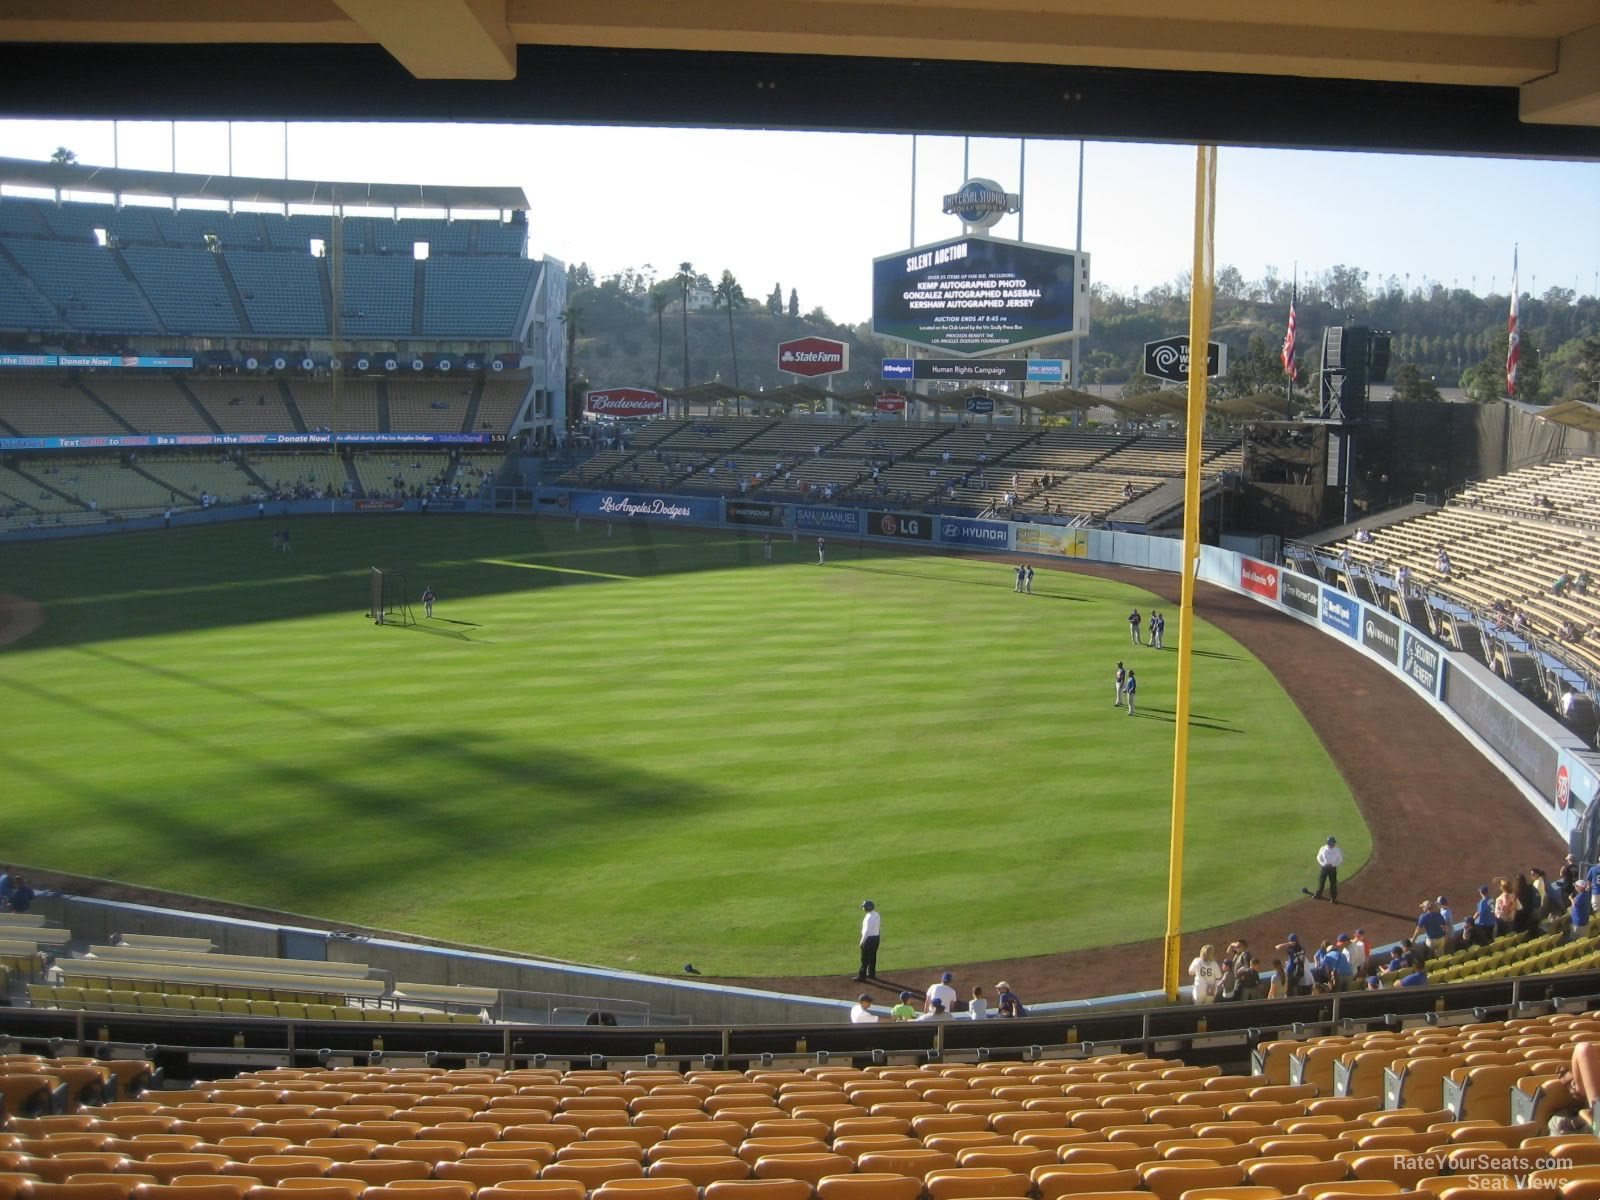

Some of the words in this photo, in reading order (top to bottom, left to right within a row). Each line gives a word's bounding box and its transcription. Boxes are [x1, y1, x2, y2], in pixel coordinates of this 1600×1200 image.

[980, 192, 1006, 206] STUDIOS
[906, 252, 933, 272] SILENT
[934, 243, 968, 265] AUCTION
[940, 280, 996, 289] AUTOGRAPHED
[998, 280, 1026, 288] PHOTO
[903, 292, 942, 300] GONZALEZ
[944, 290, 1002, 298] AUTOGRAPHED
[1002, 290, 1042, 298] BASEBALL
[910, 300, 946, 309] KERSHAW
[946, 300, 1004, 308] AUTOGRAPHED
[1006, 300, 1034, 308] JERSEY
[91, 358, 112, 366] Now!
[954, 366, 974, 374] Rights
[974, 366, 1006, 376] Campaign
[590, 394, 662, 410] Budweiser
[599, 496, 616, 512] Los
[615, 498, 651, 517] Angeles
[650, 499, 690, 520] Dodgers
[798, 510, 816, 520] SAN
[822, 513, 856, 524] MANUEL
[900, 520, 918, 534] LG
[962, 527, 1006, 541] HYUNDAI
[1374, 628, 1398, 650] INFINITI
[1414, 640, 1436, 670] SECURITY
[1413, 660, 1434, 688] BENEFIT
[1200, 966, 1212, 977] 66
